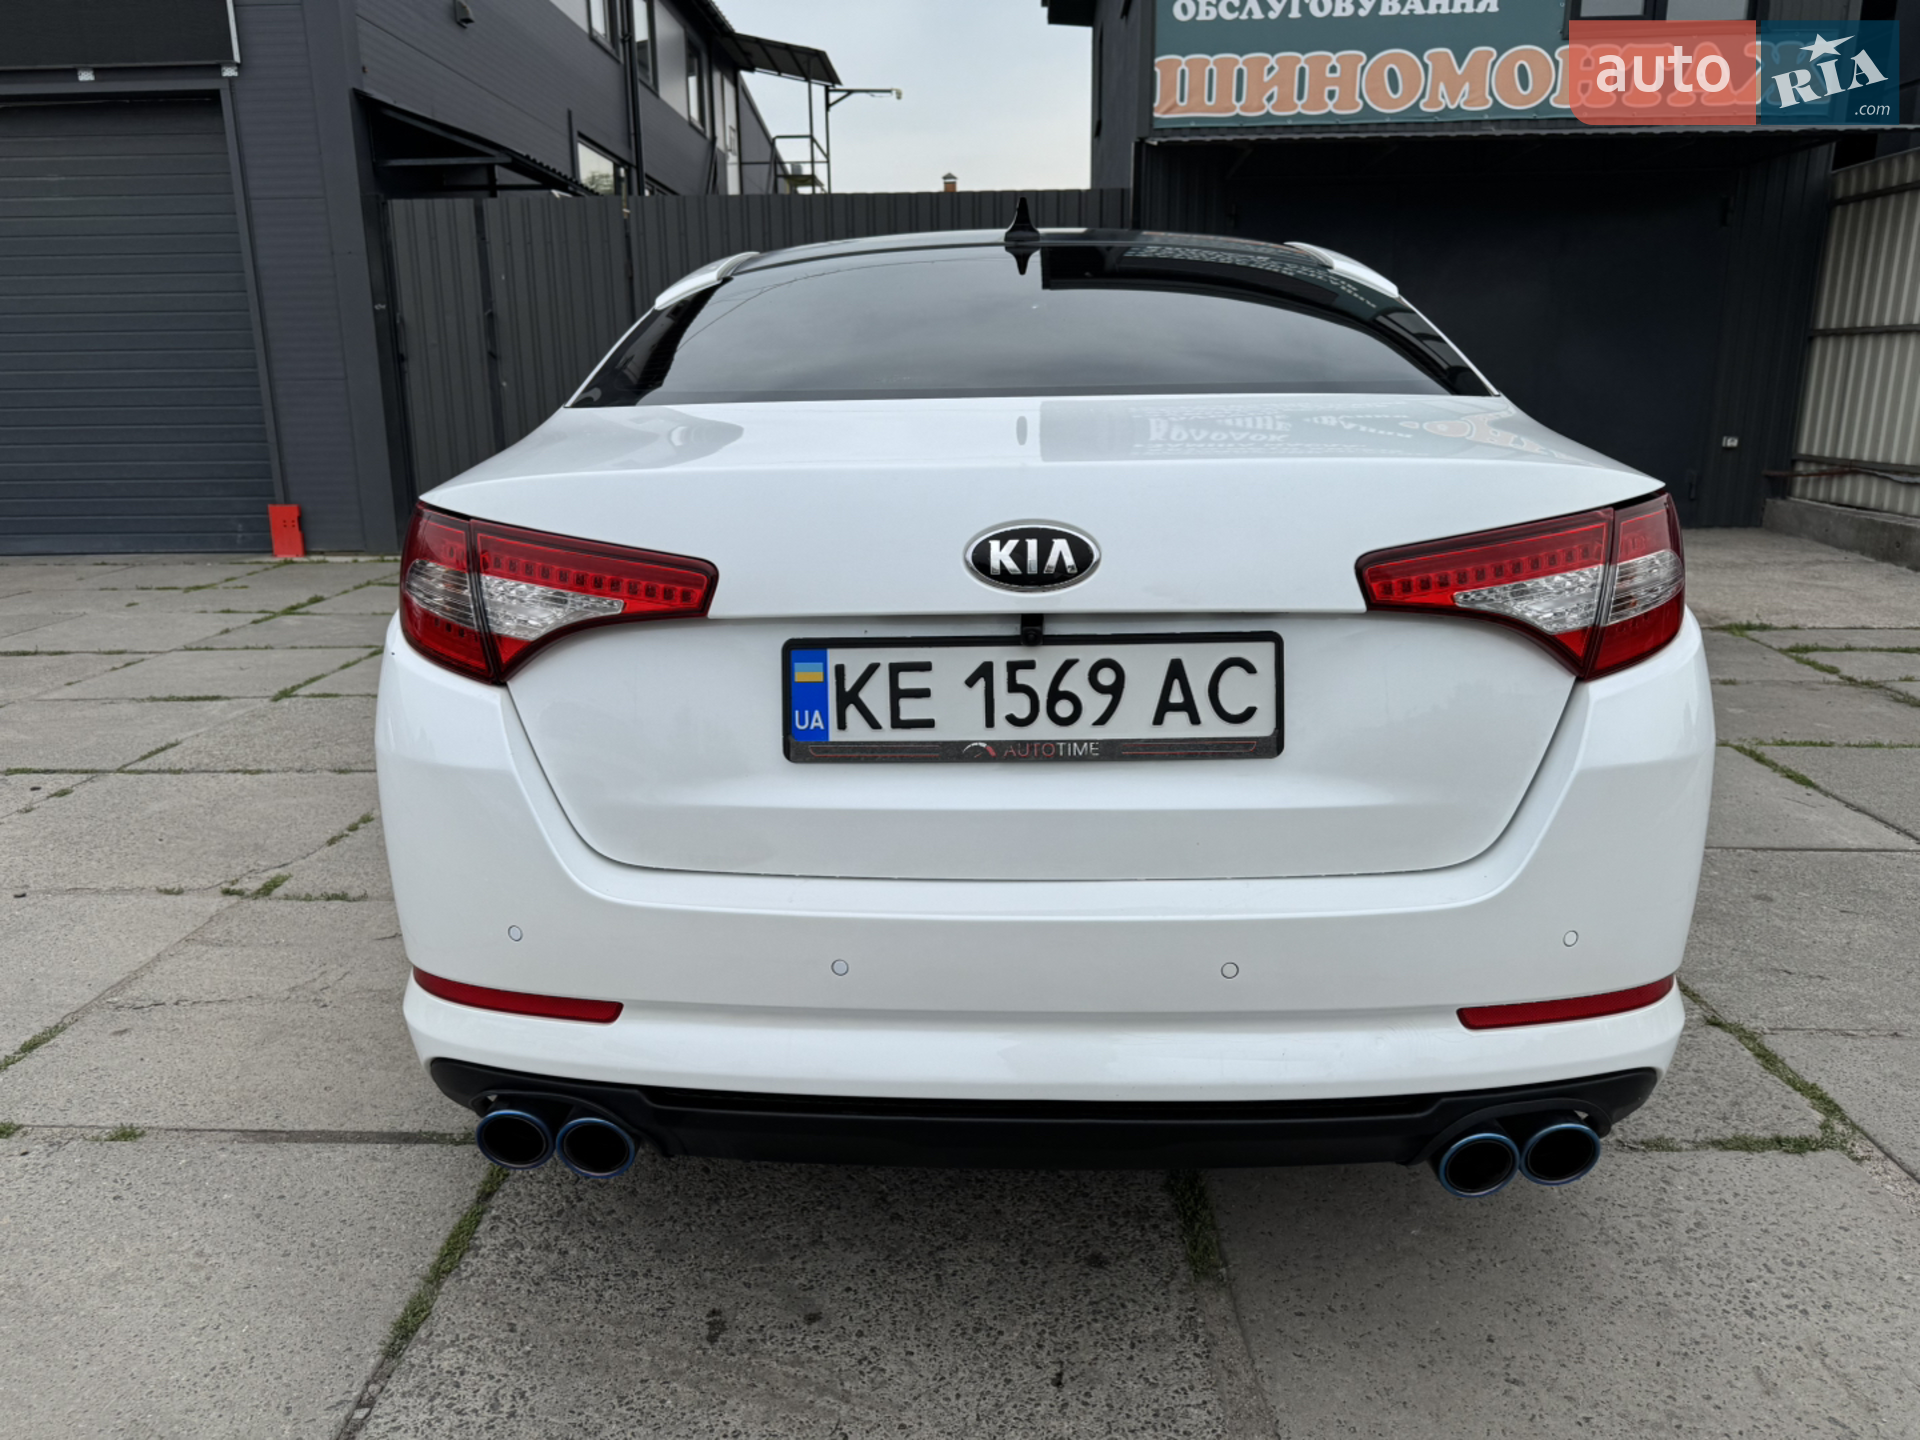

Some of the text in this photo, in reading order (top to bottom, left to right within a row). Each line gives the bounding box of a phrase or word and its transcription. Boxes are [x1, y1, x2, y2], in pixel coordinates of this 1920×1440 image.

[989, 538, 1079, 576] KIA
[834, 657, 1258, 731] KE 1569 AC
[795, 710, 825, 730] UA
[1003, 742, 1099, 757] AUTOTIME
